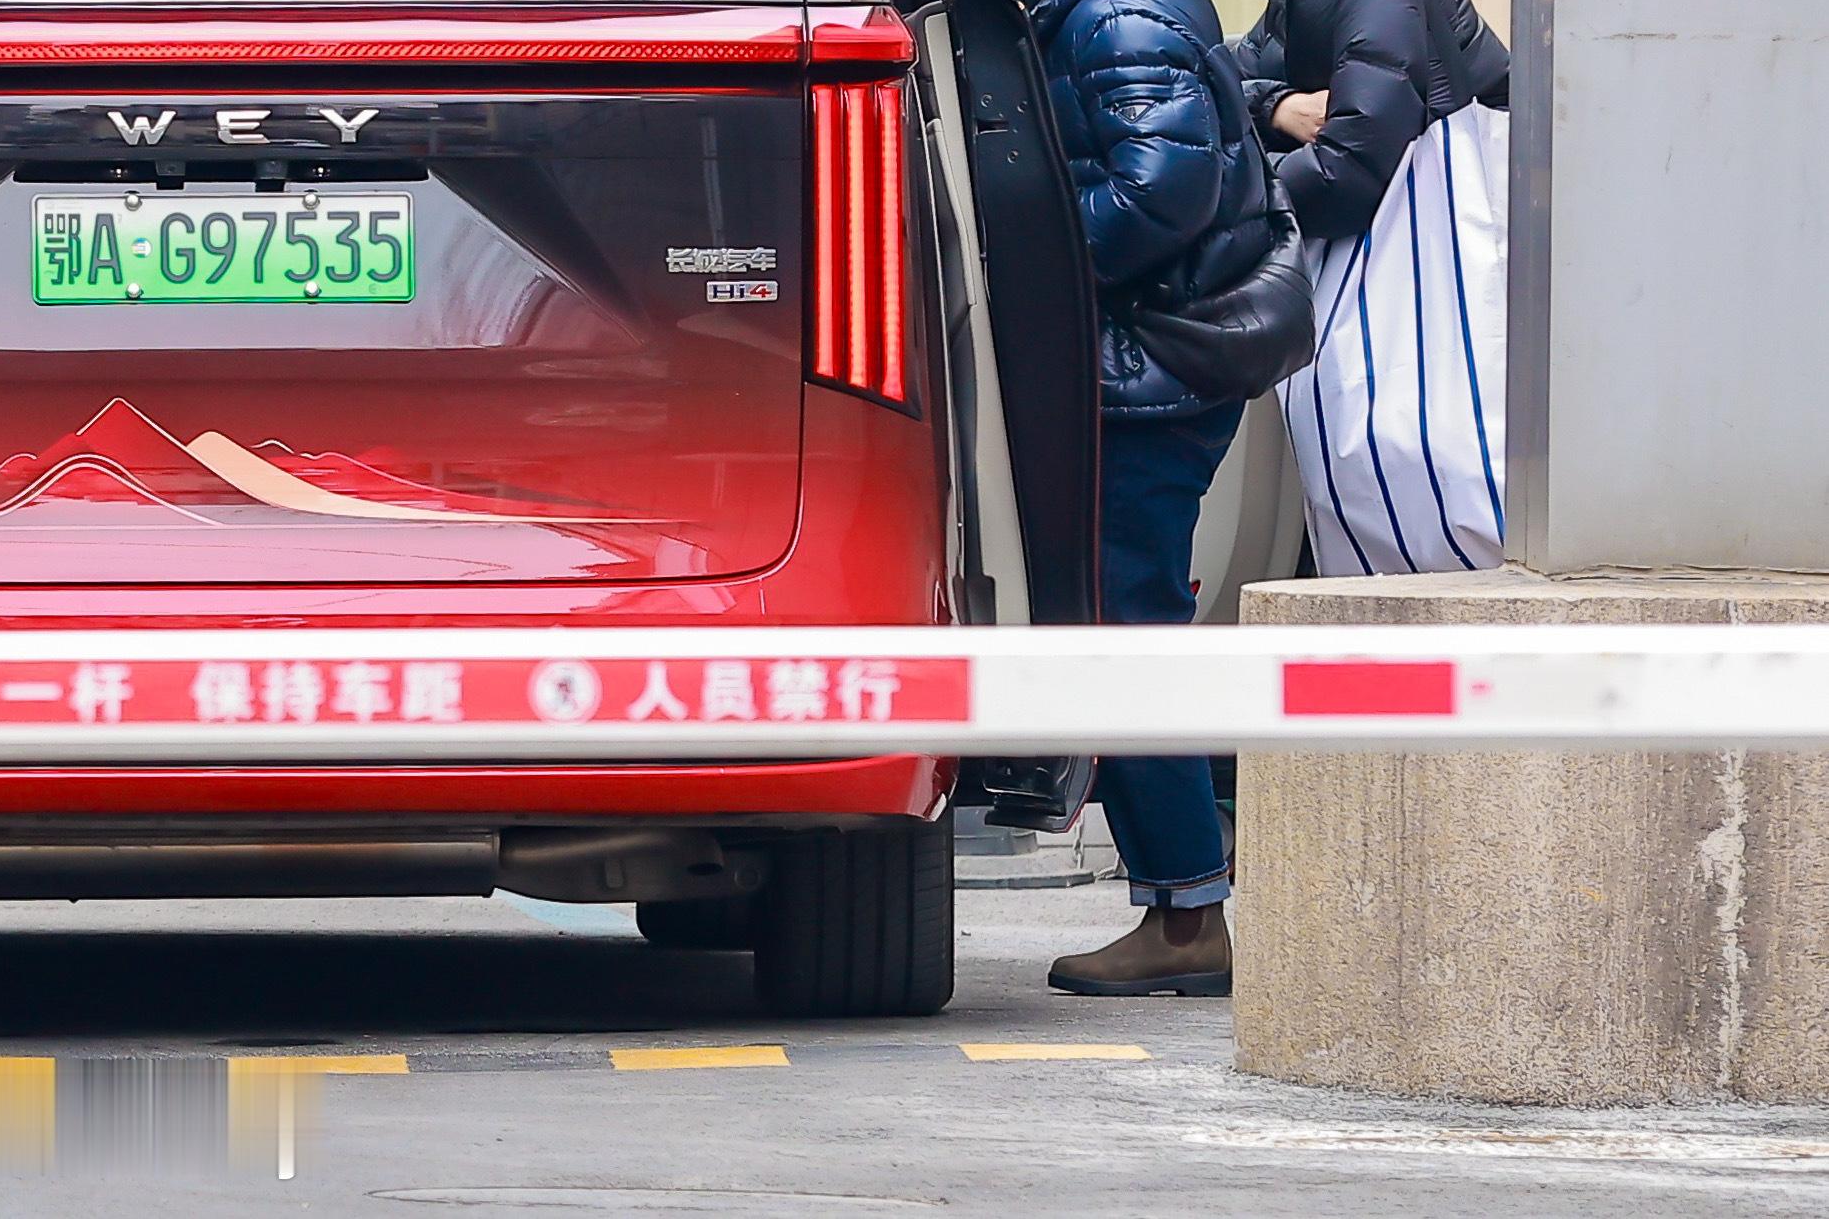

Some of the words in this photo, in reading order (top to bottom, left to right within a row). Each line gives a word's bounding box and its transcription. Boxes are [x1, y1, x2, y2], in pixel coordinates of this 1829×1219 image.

[107, 108, 380, 146] WEY
[666, 247, 777, 273] 长城汽车
[713, 284, 772, 299] Hi4
[191, 660, 463, 724] 保持车距
[627, 660, 901, 724] 人员禁行
